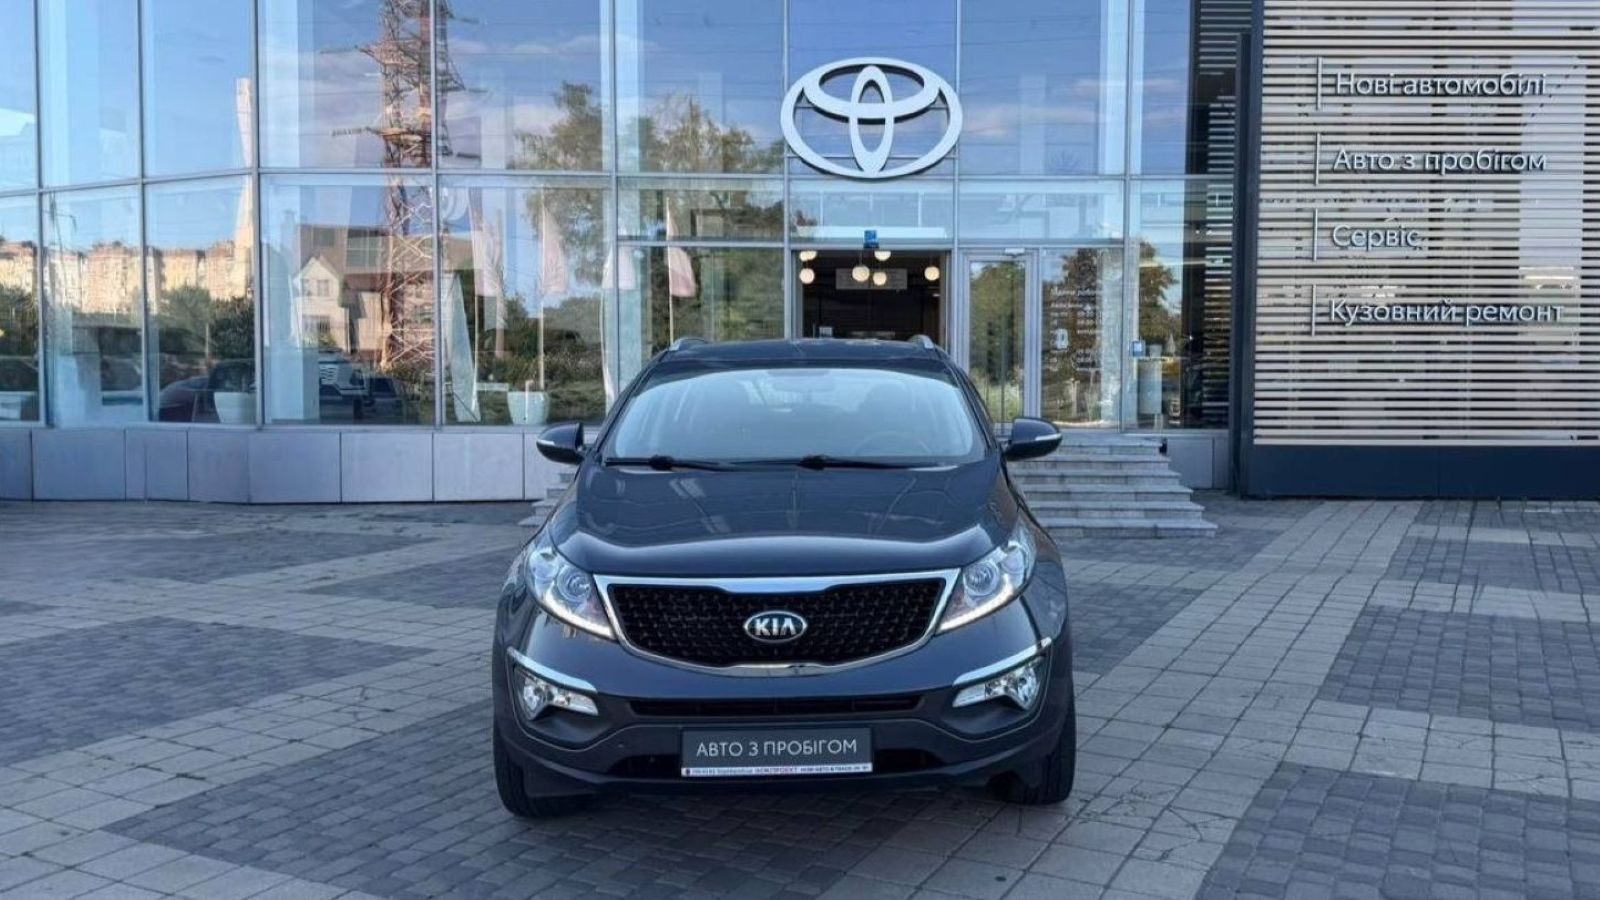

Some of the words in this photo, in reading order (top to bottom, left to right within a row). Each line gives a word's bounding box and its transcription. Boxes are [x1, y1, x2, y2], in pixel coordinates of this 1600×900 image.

[1335, 72, 1395, 96] Нові
[1403, 71, 1547, 97] автомобілі
[1333, 149, 1395, 171] Авто
[1402, 155, 1416, 172] з
[1425, 149, 1547, 176] пробігом
[1332, 225, 1420, 251] Сервіс
[1330, 299, 1457, 327] Кузовний
[1466, 305, 1564, 327] ремонт
[754, 617, 797, 636] KIA
[696, 742, 743, 757] АВТО
[748, 742, 759, 757] З
[763, 739, 857, 756] ПРОБІГОМ
